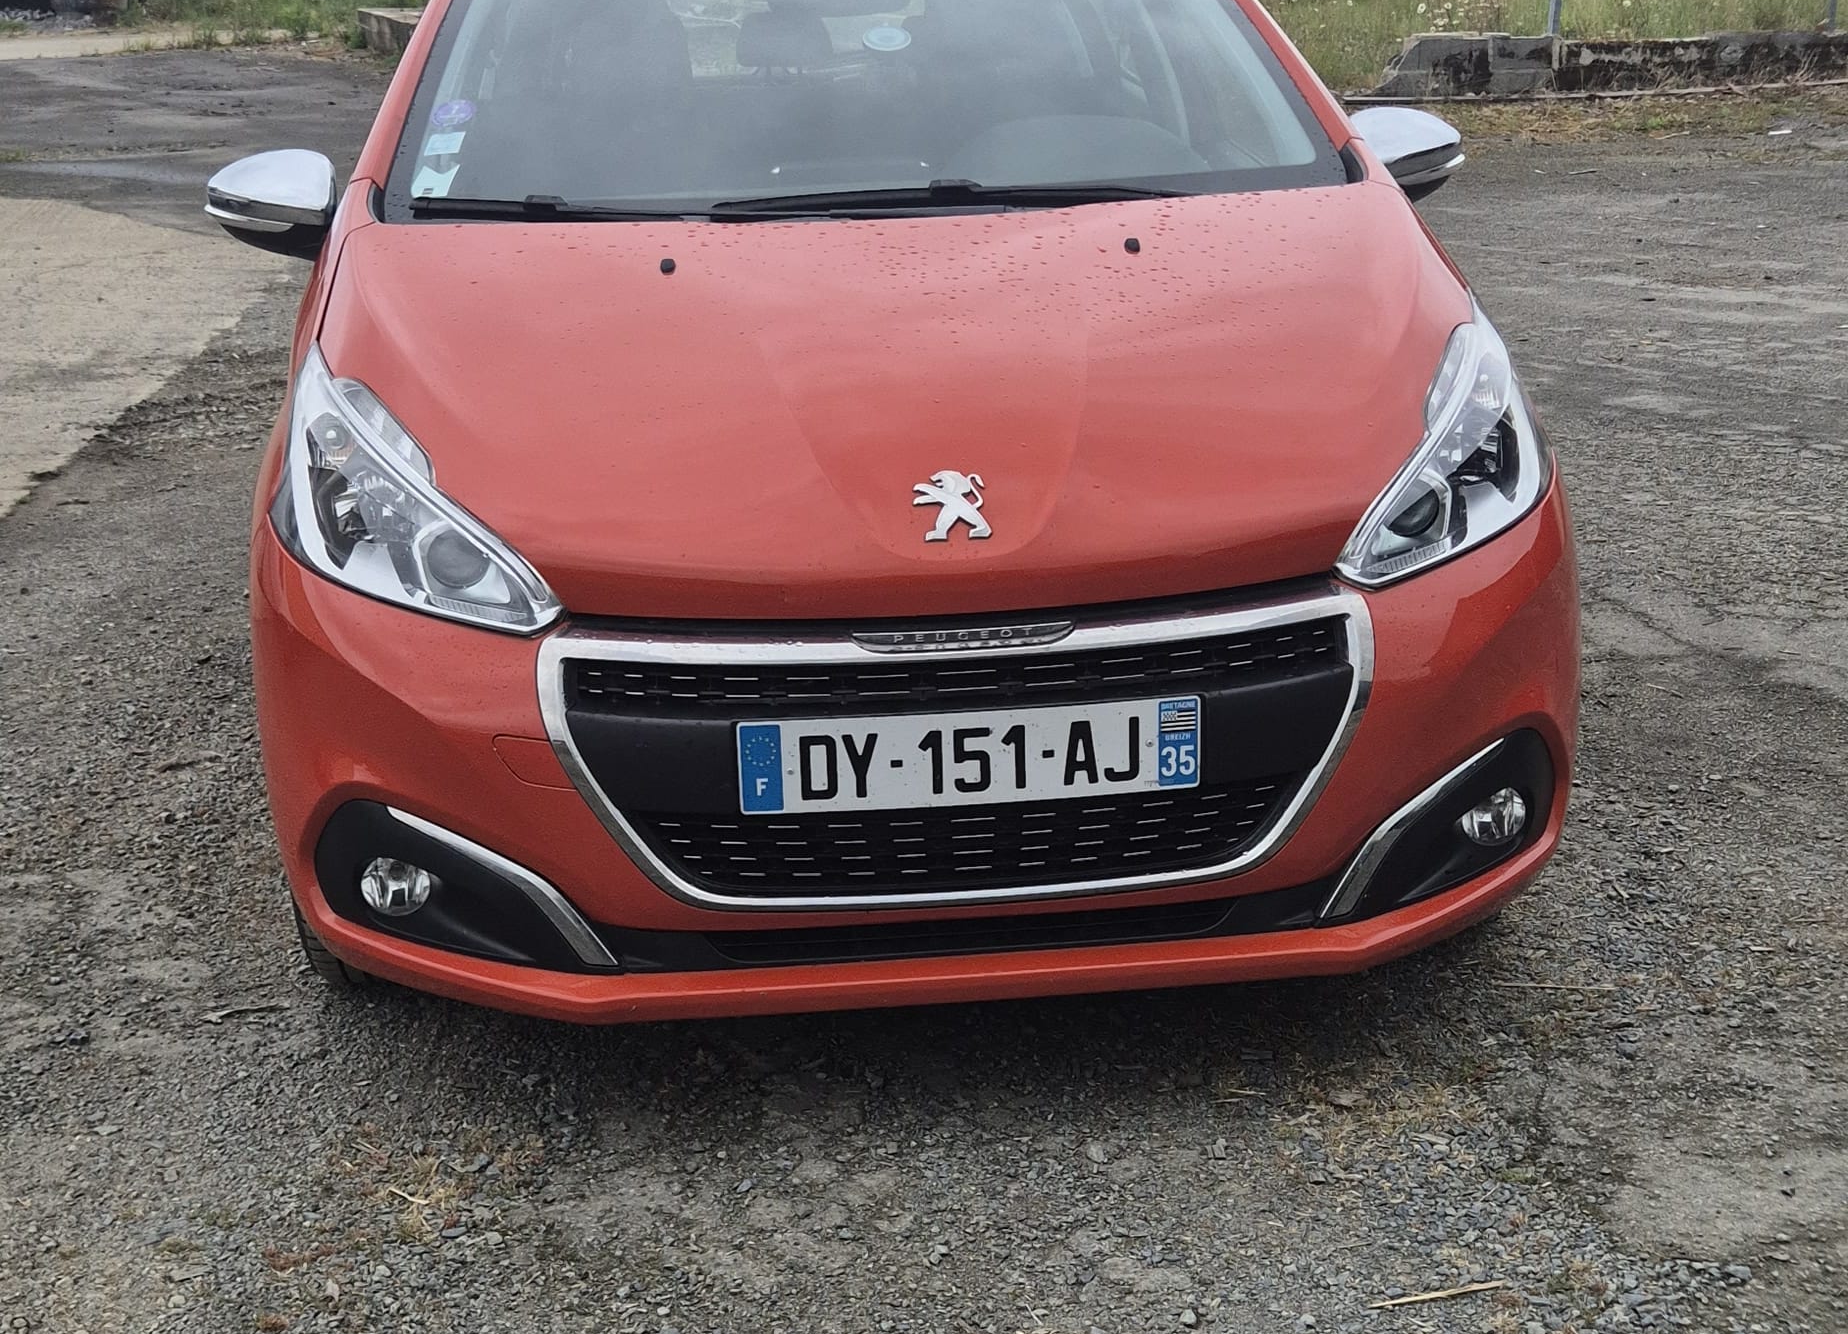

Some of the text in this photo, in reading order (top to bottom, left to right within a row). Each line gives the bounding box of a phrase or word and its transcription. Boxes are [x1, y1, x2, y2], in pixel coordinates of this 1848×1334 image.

[893, 628, 1033, 643] PEUGEOT
[799, 716, 1140, 801] DY-151-AJ
[1161, 745, 1196, 777] 35
[756, 778, 769, 796] F
